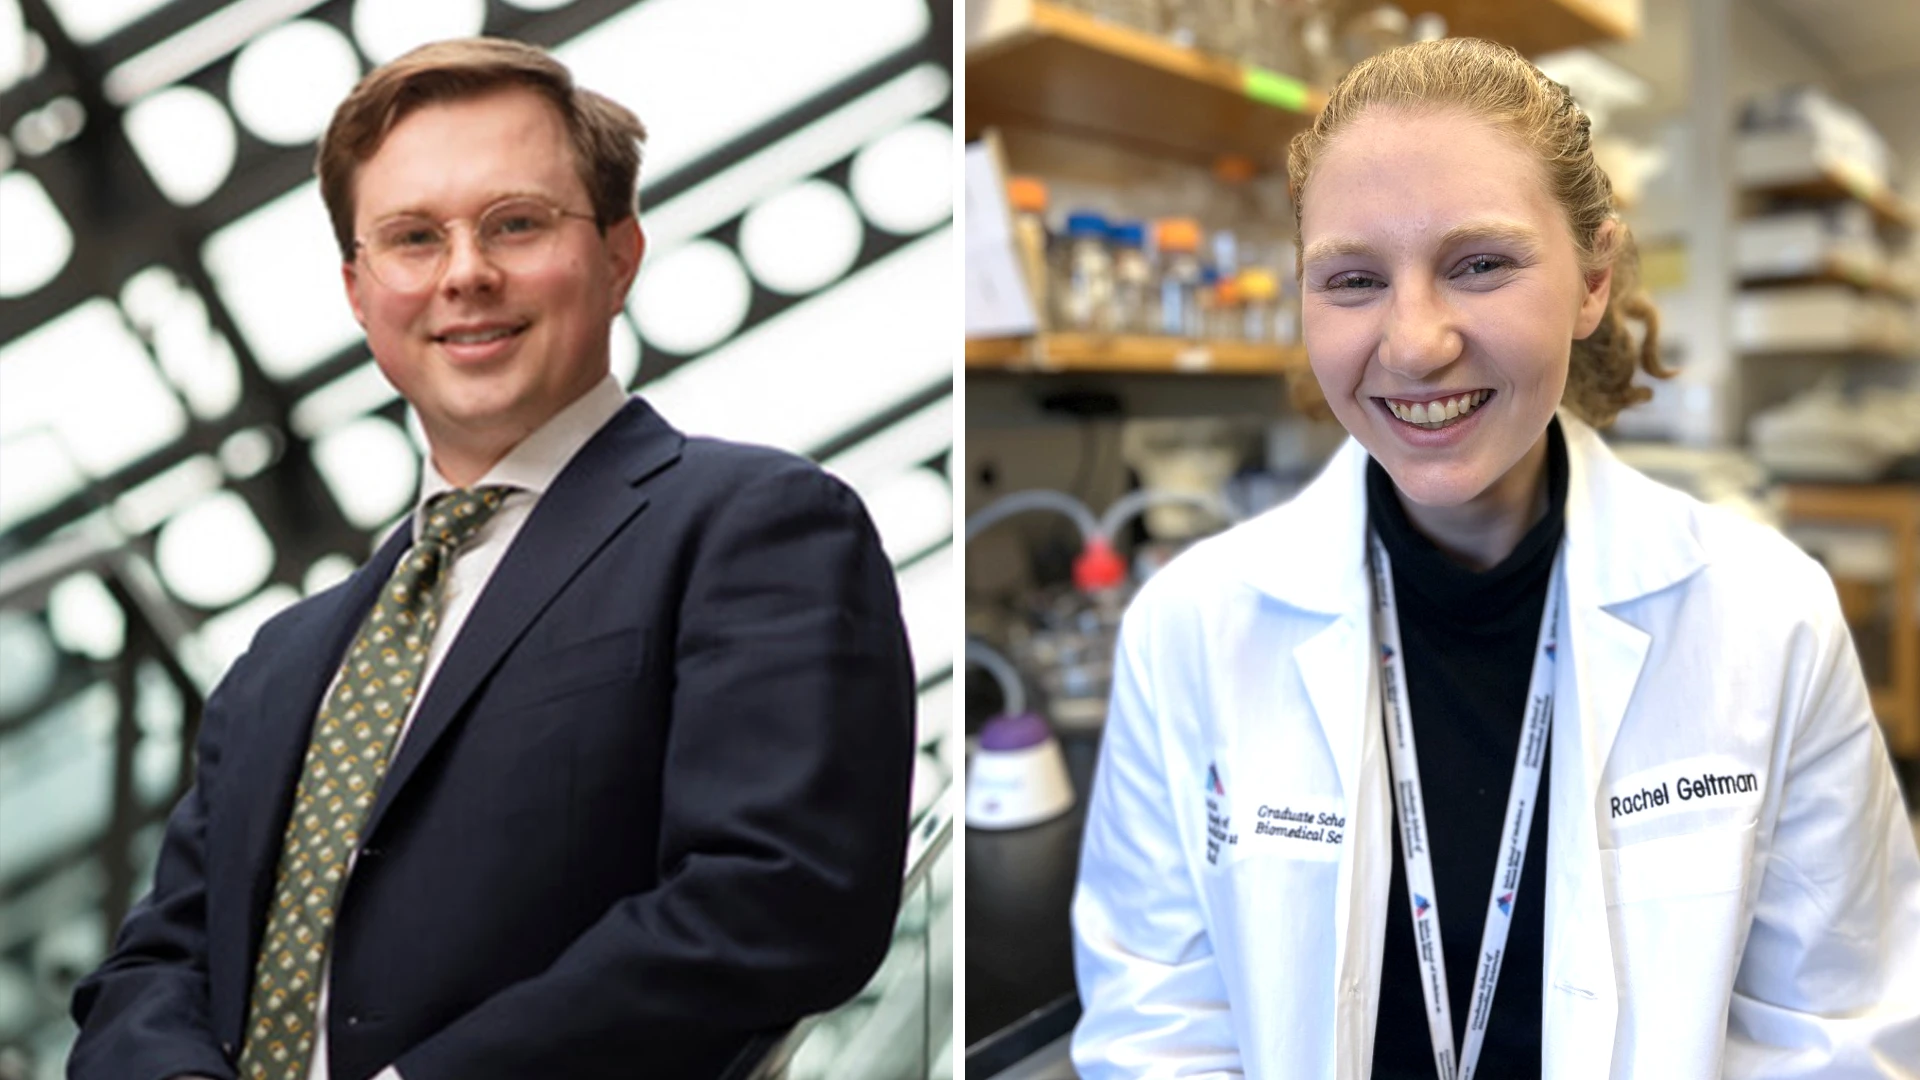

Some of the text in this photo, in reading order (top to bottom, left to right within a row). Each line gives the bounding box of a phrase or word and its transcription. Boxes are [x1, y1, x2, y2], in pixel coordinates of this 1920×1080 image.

[1610, 772, 1758, 819] Rachel Geltman
[1257, 805, 1315, 824] Graduate
[1255, 821, 1324, 842] Biomedical
